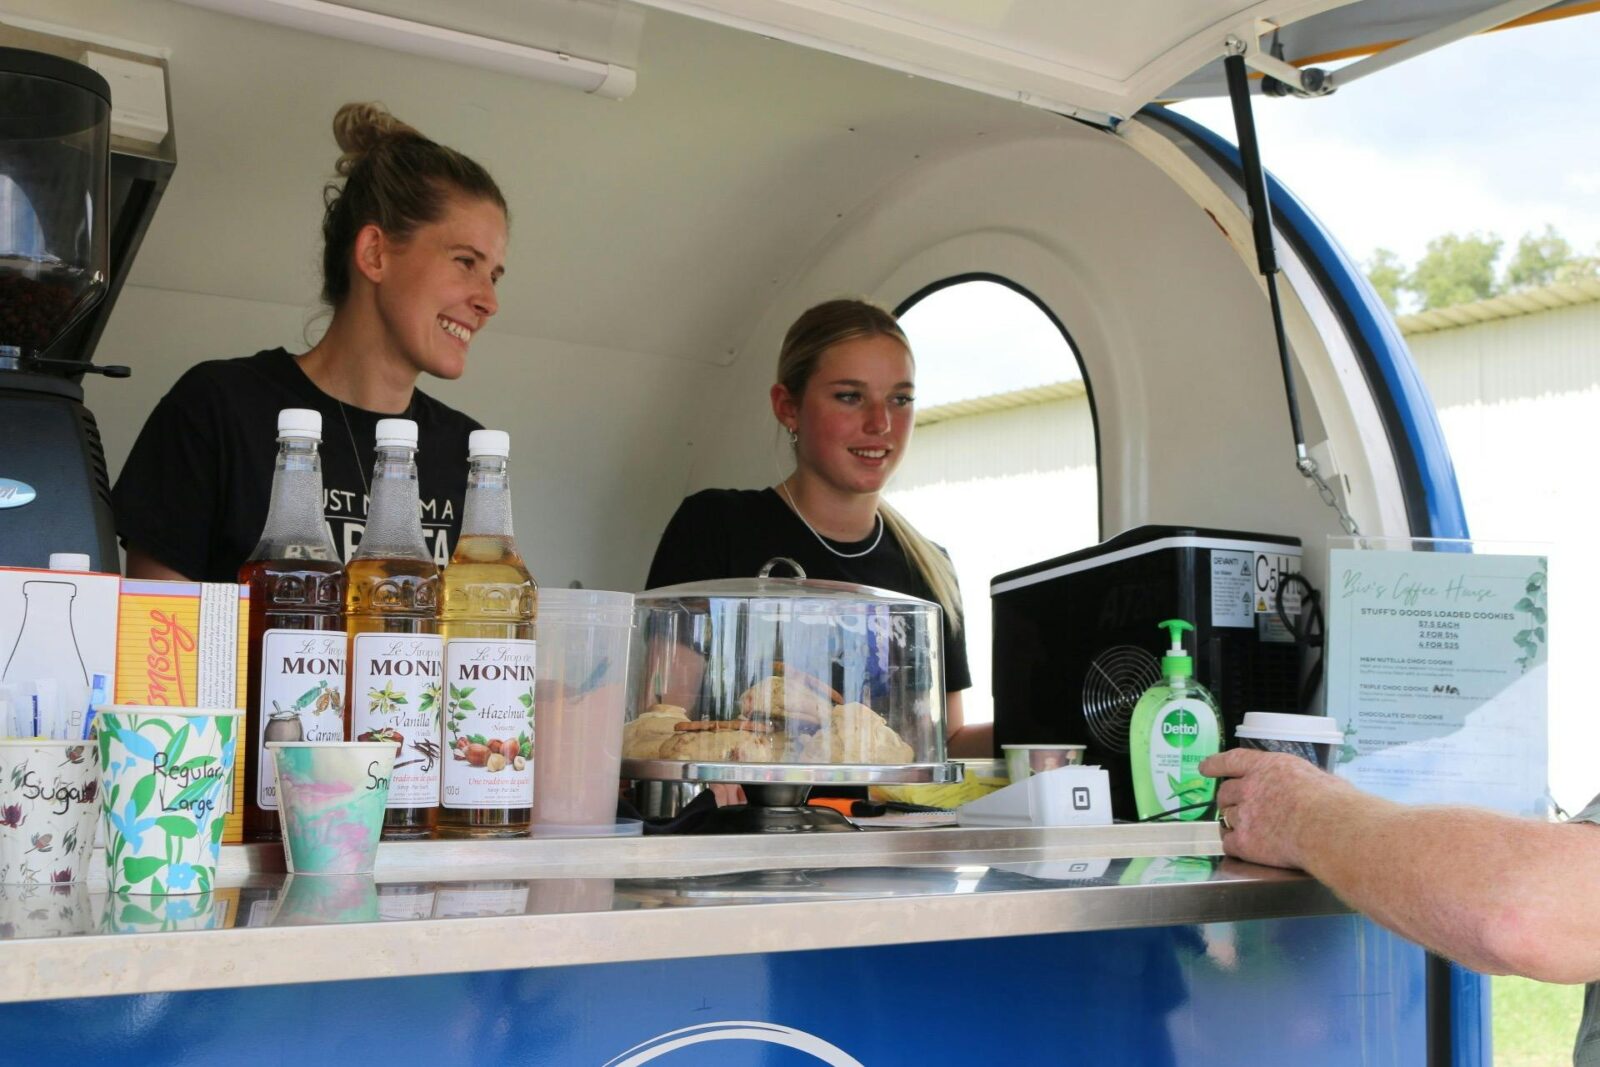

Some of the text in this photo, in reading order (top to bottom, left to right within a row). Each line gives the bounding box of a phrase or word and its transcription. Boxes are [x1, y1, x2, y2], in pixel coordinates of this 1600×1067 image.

[441, 499, 454, 520] A
[1392, 572, 1439, 606] Coffee
[1444, 574, 1497, 603] House
[1399, 609, 1432, 618] GOODS
[1434, 611, 1470, 619] LOADED
[1471, 612, 1515, 620] COOKIES
[1436, 622, 1460, 630] EACH
[1426, 631, 1443, 639] FOR
[296, 639, 317, 654] Le
[382, 642, 403, 656] Le
[1426, 641, 1443, 650] FOR
[147, 609, 195, 706] onsoy
[470, 646, 490, 661] Le
[281, 657, 345, 675] MONI
[478, 704, 525, 719] Hazelnut
[1358, 711, 1399, 719] CHOCOLATE
[389, 711, 431, 728] Vanilla
[1163, 722, 1198, 735] Dettol
[153, 752, 226, 788] Regular
[23, 771, 90, 815] Sugar
[159, 788, 215, 819] Large
